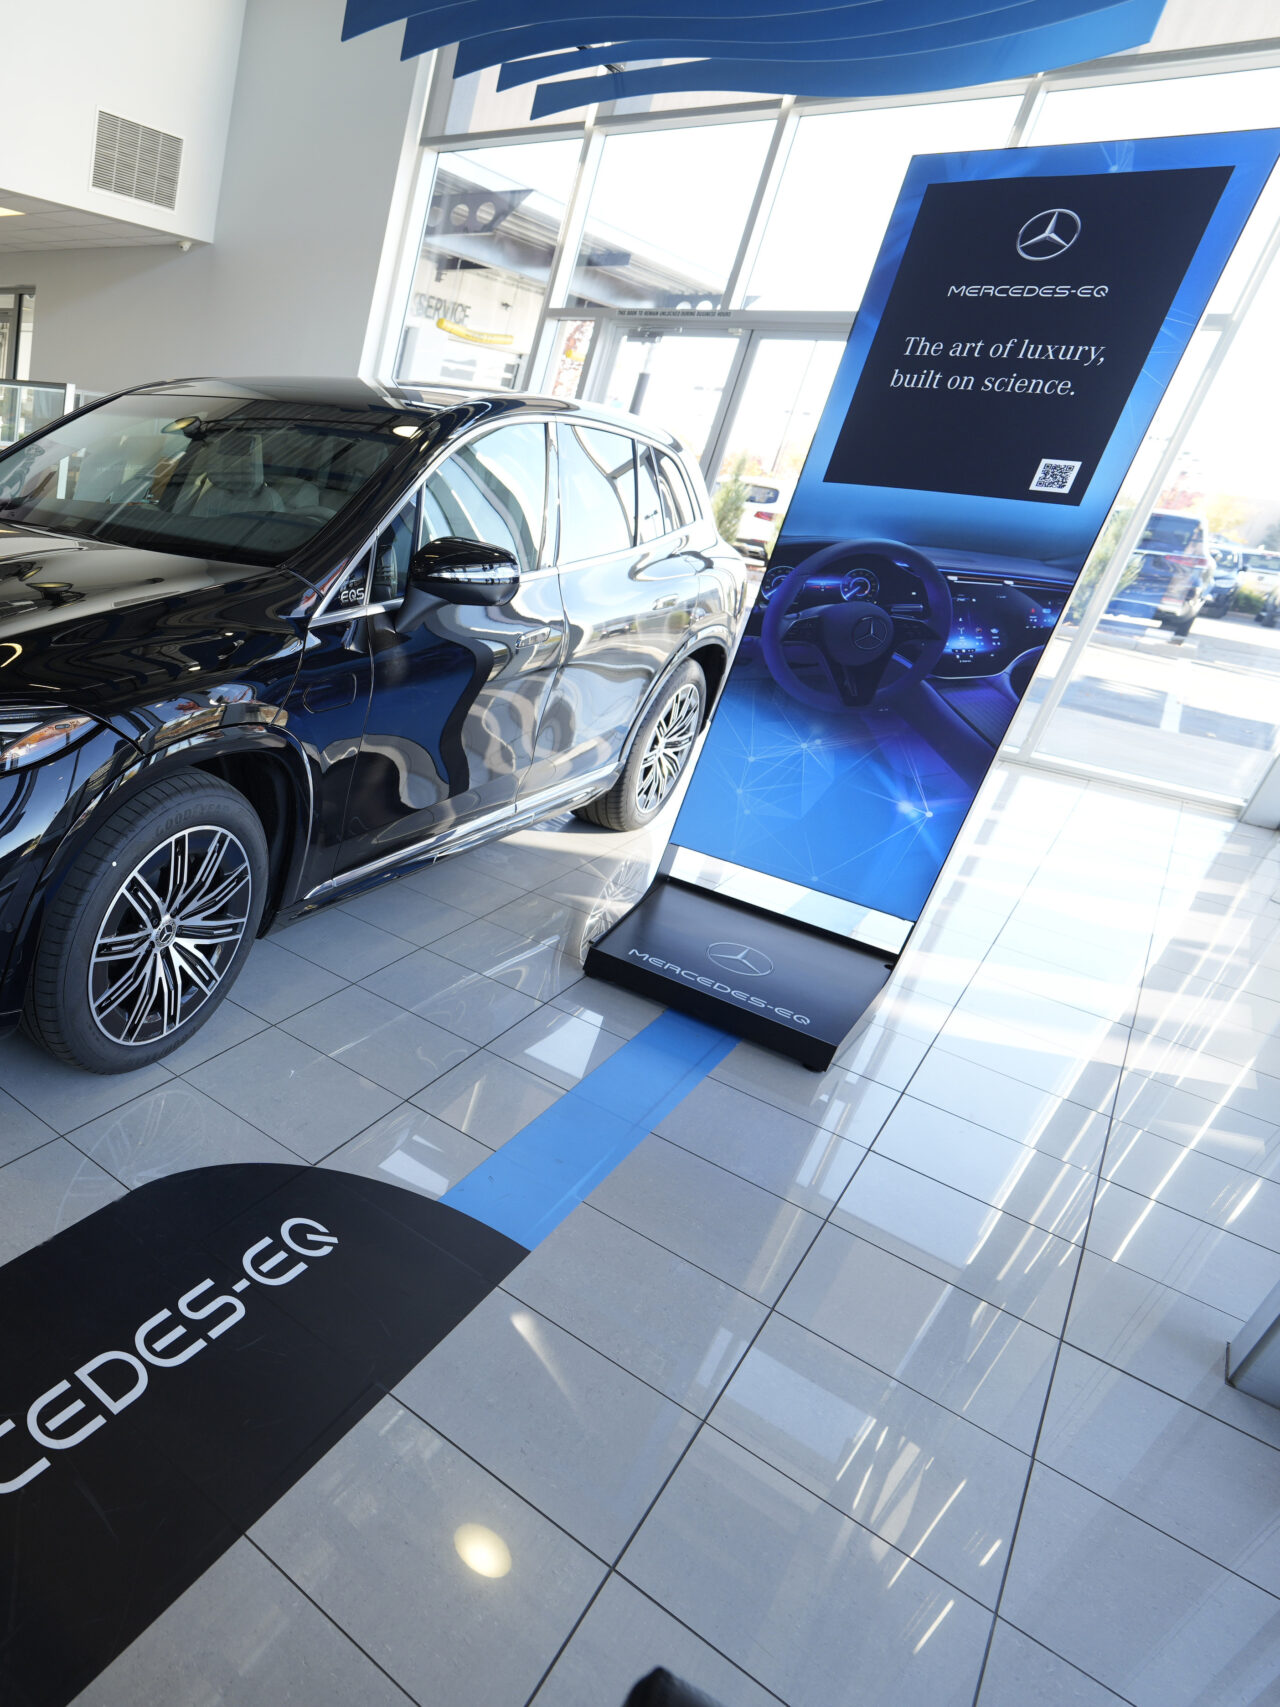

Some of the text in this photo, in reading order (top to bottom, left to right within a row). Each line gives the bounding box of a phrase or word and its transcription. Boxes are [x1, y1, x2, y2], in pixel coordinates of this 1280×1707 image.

[947, 285, 1109, 298] MERCEDES-EQ
[903, 336, 1106, 367] The art of luxury,
[890, 368, 1076, 396] built on science.
[340, 588, 365, 602] EQS
[628, 949, 811, 1026] MERCEDES-EQ
